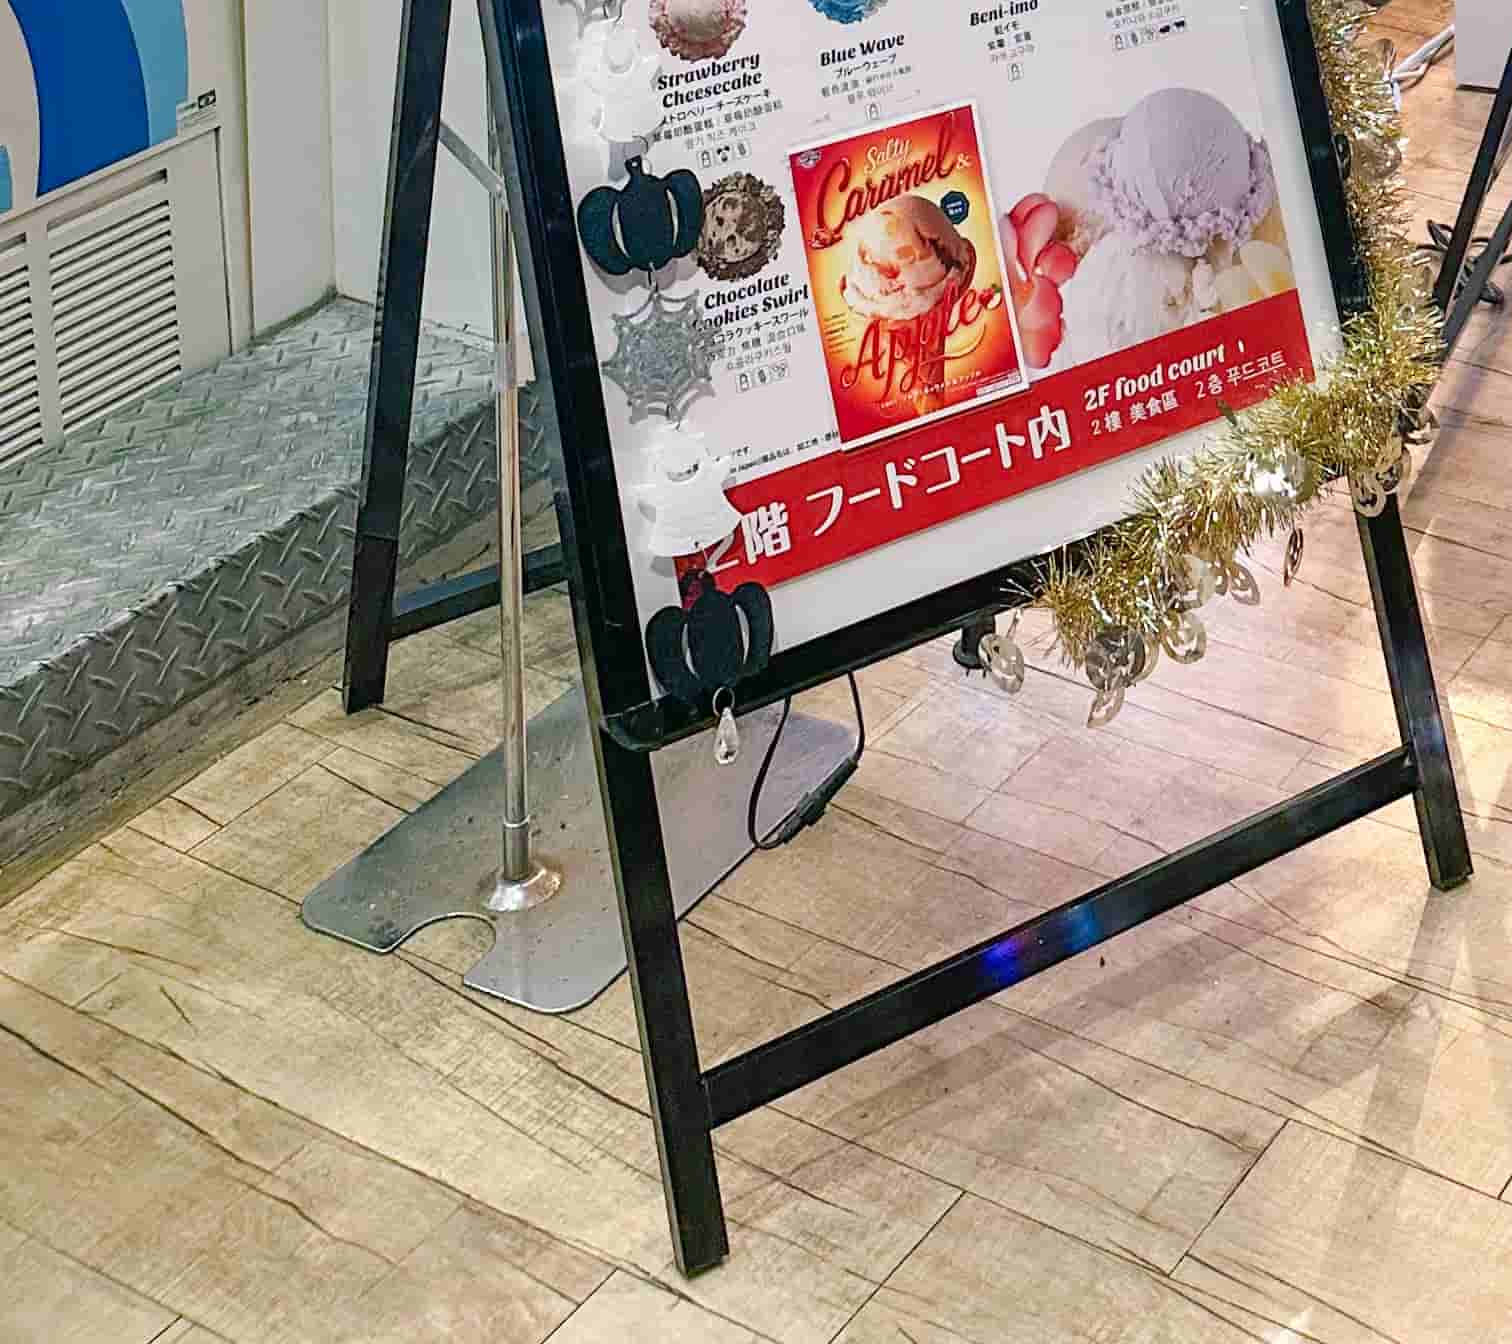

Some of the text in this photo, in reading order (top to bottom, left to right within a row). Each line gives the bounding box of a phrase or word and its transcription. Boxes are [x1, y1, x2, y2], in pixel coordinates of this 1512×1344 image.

[820, 33, 905, 67] Blue Wave
[657, 52, 761, 91] Strawberry
[662, 71, 762, 109] Cheesecake
[815, 120, 957, 236] Caramel
[703, 272, 791, 310] Chocolate
[761, 284, 810, 314] Swirl
[840, 276, 984, 402] Apple
[1084, 343, 1226, 412] 2F food court
[805, 404, 1072, 538] フードコート内
